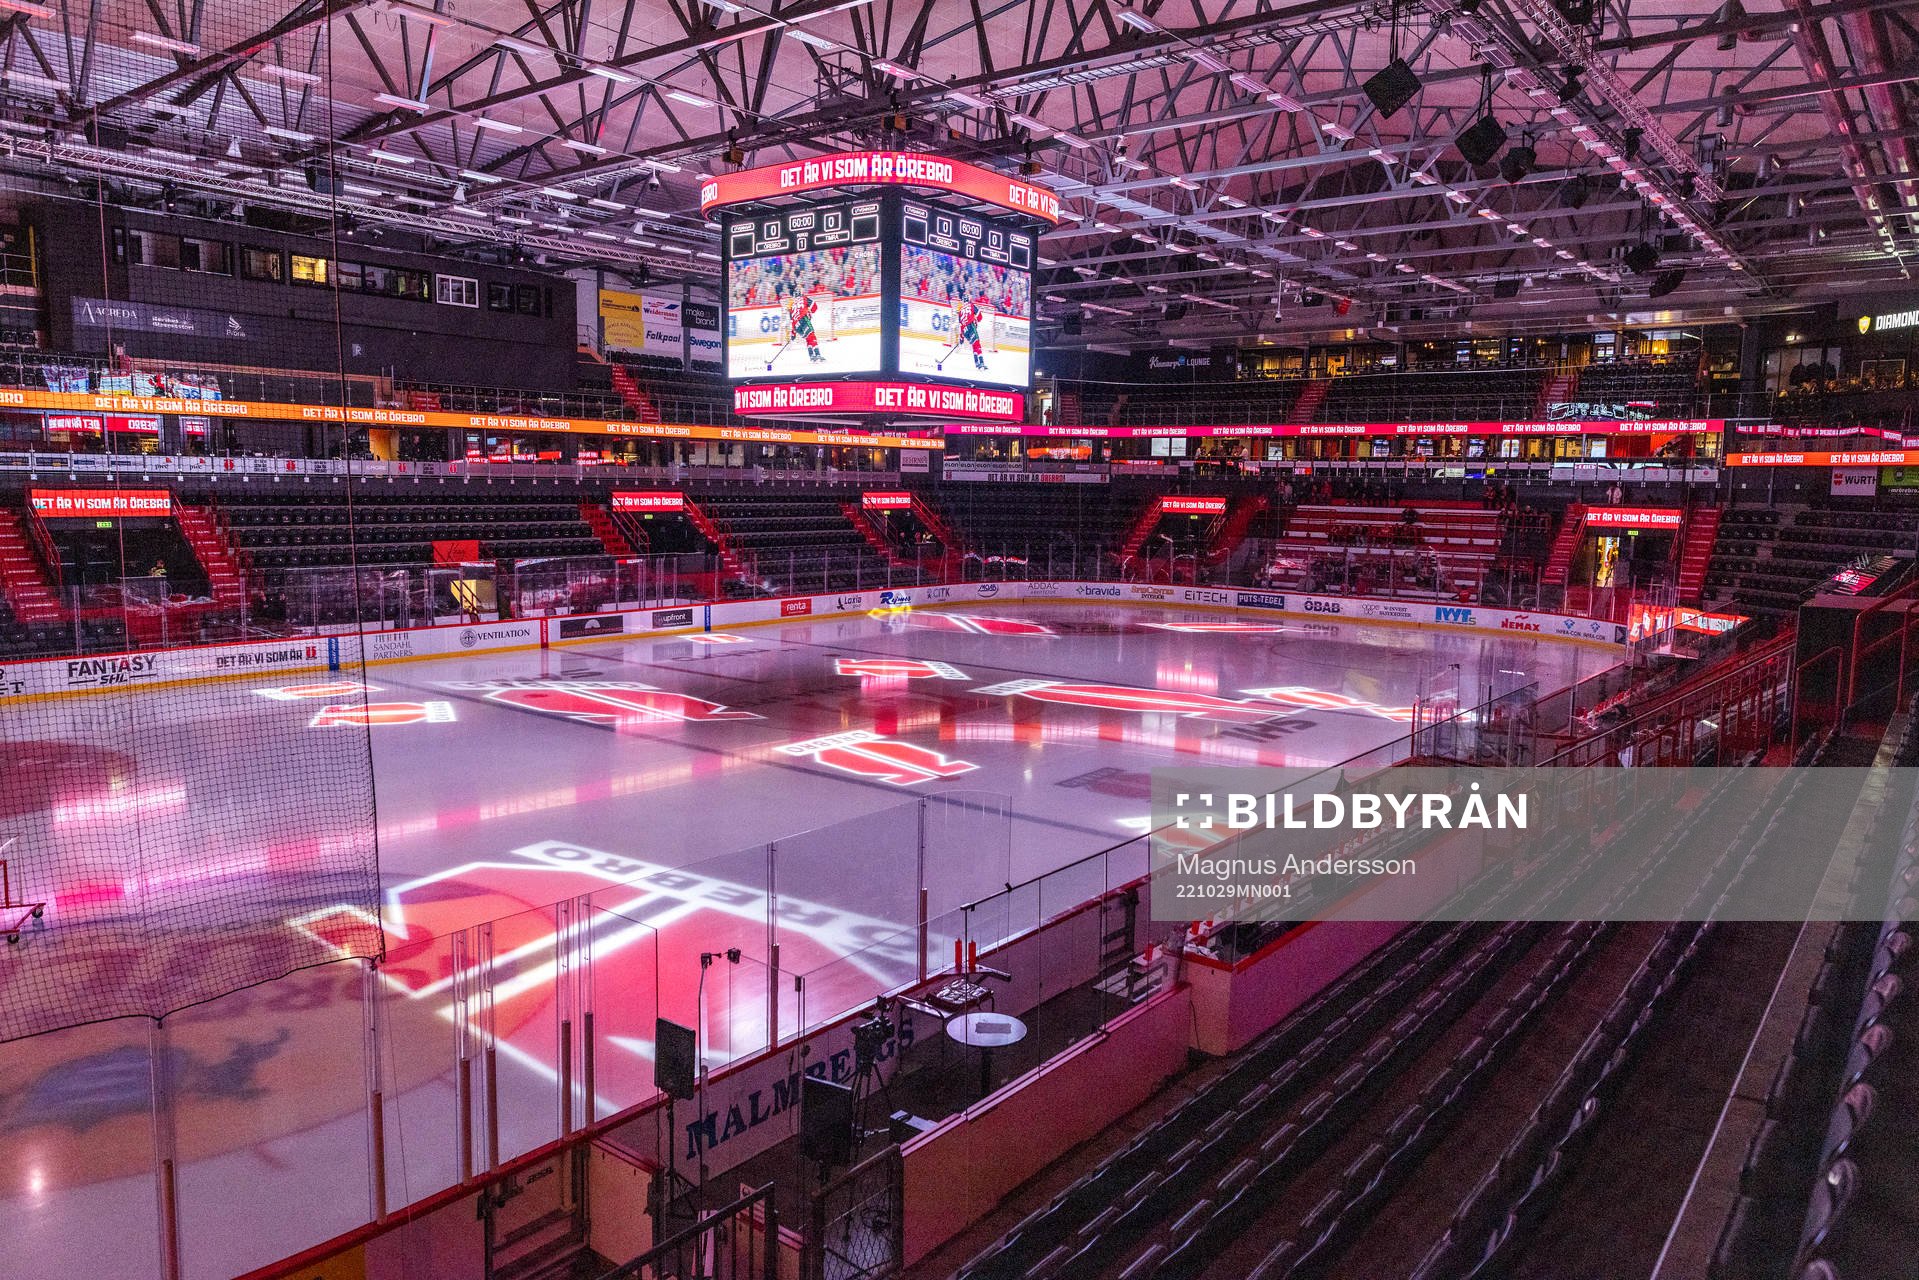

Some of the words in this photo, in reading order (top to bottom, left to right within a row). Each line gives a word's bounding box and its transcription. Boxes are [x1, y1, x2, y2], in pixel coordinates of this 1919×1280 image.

[781, 166, 802, 188] DET
[804, 164, 819, 184] ÄR
[822, 161, 833, 180] VI
[836, 158, 867, 178] SOM
[871, 155, 892, 176] ÄR
[896, 156, 952, 184] ÖREBRO
[1010, 184, 1026, 205] DET
[1028, 188, 1039, 210] ÄR
[1040, 195, 1049, 213] VI
[792, 217, 812, 228] 60:00
[828, 216, 834, 227] 0
[942, 222, 948, 232] 0
[770, 226, 776, 236] 0
[992, 235, 998, 246] 0
[742, 389, 749, 408] VI
[750, 390, 772, 408] SOM
[774, 387, 788, 408] ÄR
[788, 386, 833, 407] ÖREBRO
[876, 388, 904, 406] DET
[908, 387, 926, 408] ÄR
[930, 391, 940, 408] VI
[942, 392, 964, 410] SOM
[966, 392, 978, 412] ÄR
[978, 393, 1013, 414] ÖREBRO
[96, 398, 118, 408] DET
[122, 396, 138, 409] ÄR
[142, 400, 153, 410] VI
[156, 400, 182, 411] SOM
[186, 402, 200, 412] ÄR
[203, 402, 248, 414] ÖREBRO
[304, 408, 322, 417] DET
[325, 408, 338, 418] ÄR
[341, 410, 350, 419] VI
[352, 411, 372, 420] SOM
[375, 412, 386, 421] ÄR
[390, 412, 424, 423] ÖREBRO
[470, 417, 486, 426] DET
[488, 416, 499, 427] ÄR
[500, 419, 508, 428] VI
[510, 420, 527, 428] SOM
[529, 418, 538, 428] ÄR
[540, 419, 570, 430] ÖREBRO
[1515, 423, 1524, 432] ÄR
[1547, 423, 1555, 432] ÄR
[1556, 422, 1580, 432] ÖREBRO
[1634, 422, 1642, 430] ÄR
[1652, 422, 1666, 430] SOM
[1668, 422, 1678, 430] ÄR
[1679, 422, 1706, 430] ÖREBRO
[607, 424, 620, 432] DET
[622, 424, 630, 433] ÄR
[640, 426, 654, 434] SOM
[656, 426, 664, 434] ÄR
[666, 426, 690, 436] ÖREBRO
[1830, 454, 1841, 463] DET
[1842, 454, 1850, 463] ÄR
[1851, 454, 1857, 462] VI
[1858, 454, 1870, 462] SOM
[1871, 453, 1880, 462] ÄR
[1880, 452, 1904, 462] ÖREBRO
[33, 498, 54, 509] DET
[56, 498, 72, 509] ÄR
[74, 498, 84, 508] VI
[88, 499, 110, 508] SOM
[114, 498, 127, 509] ÄR
[130, 497, 171, 508] ÖREBRO
[1588, 513, 1600, 521] DET
[1602, 512, 1612, 522] ÄR
[1614, 514, 1620, 522] VI
[1622, 514, 1638, 522] SOM
[1640, 513, 1650, 522] ÄR
[1652, 514, 1681, 522] ÖREBRO
[1086, 586, 1120, 596] bravida
[786, 602, 806, 612] renta
[1304, 598, 1340, 613] ÖBAB
[478, 629, 530, 641] VENTILATION
[217, 656, 236, 668] DET
[239, 652, 252, 666] ÄR
[254, 654, 264, 664] VI
[266, 652, 288, 663] SOM
[290, 650, 302, 662] ÄR
[374, 650, 412, 660] PARTNERS
[68, 655, 156, 678] FANTASY
[100, 674, 128, 684] SHL
